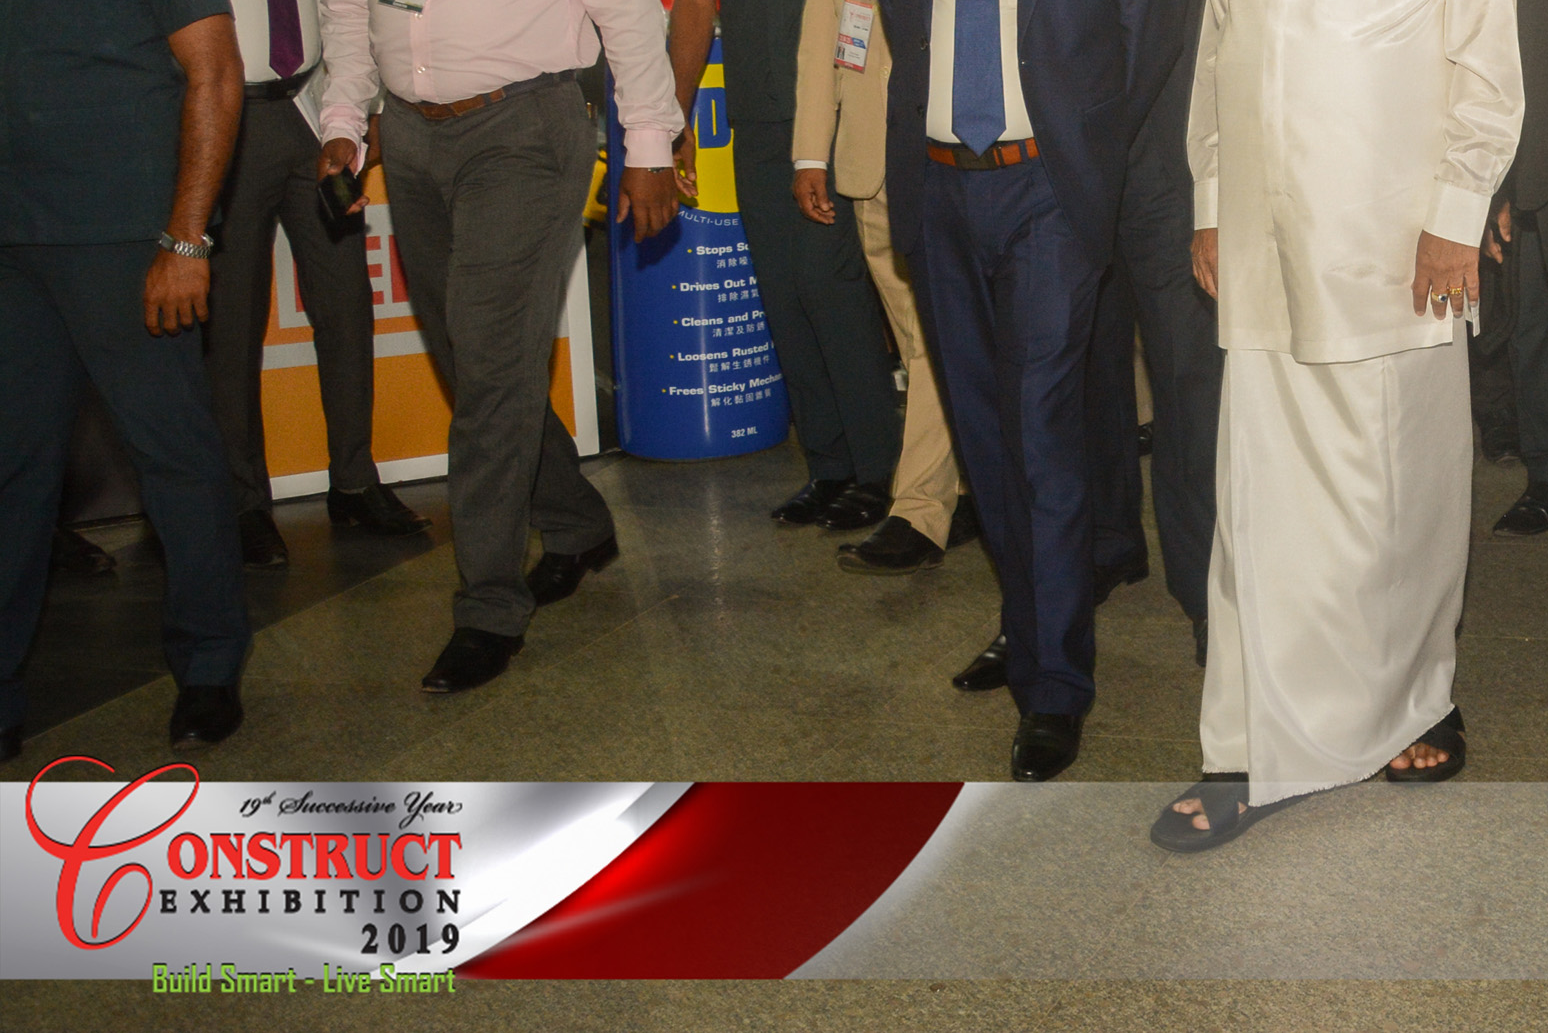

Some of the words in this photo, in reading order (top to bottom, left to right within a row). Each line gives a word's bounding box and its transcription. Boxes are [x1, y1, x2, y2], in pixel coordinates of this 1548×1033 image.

[696, 245, 733, 256] Stops
[680, 282, 720, 292] Drives
[724, 278, 746, 289] Out
[681, 317, 723, 327] Cleans
[728, 312, 748, 322] and
[678, 351, 728, 362] Loosens
[732, 342, 769, 357] Rusted
[669, 386, 704, 396] Frees
[708, 382, 746, 394] Sticky
[731, 428, 745, 439] 382
[747, 426, 759, 436] ML
